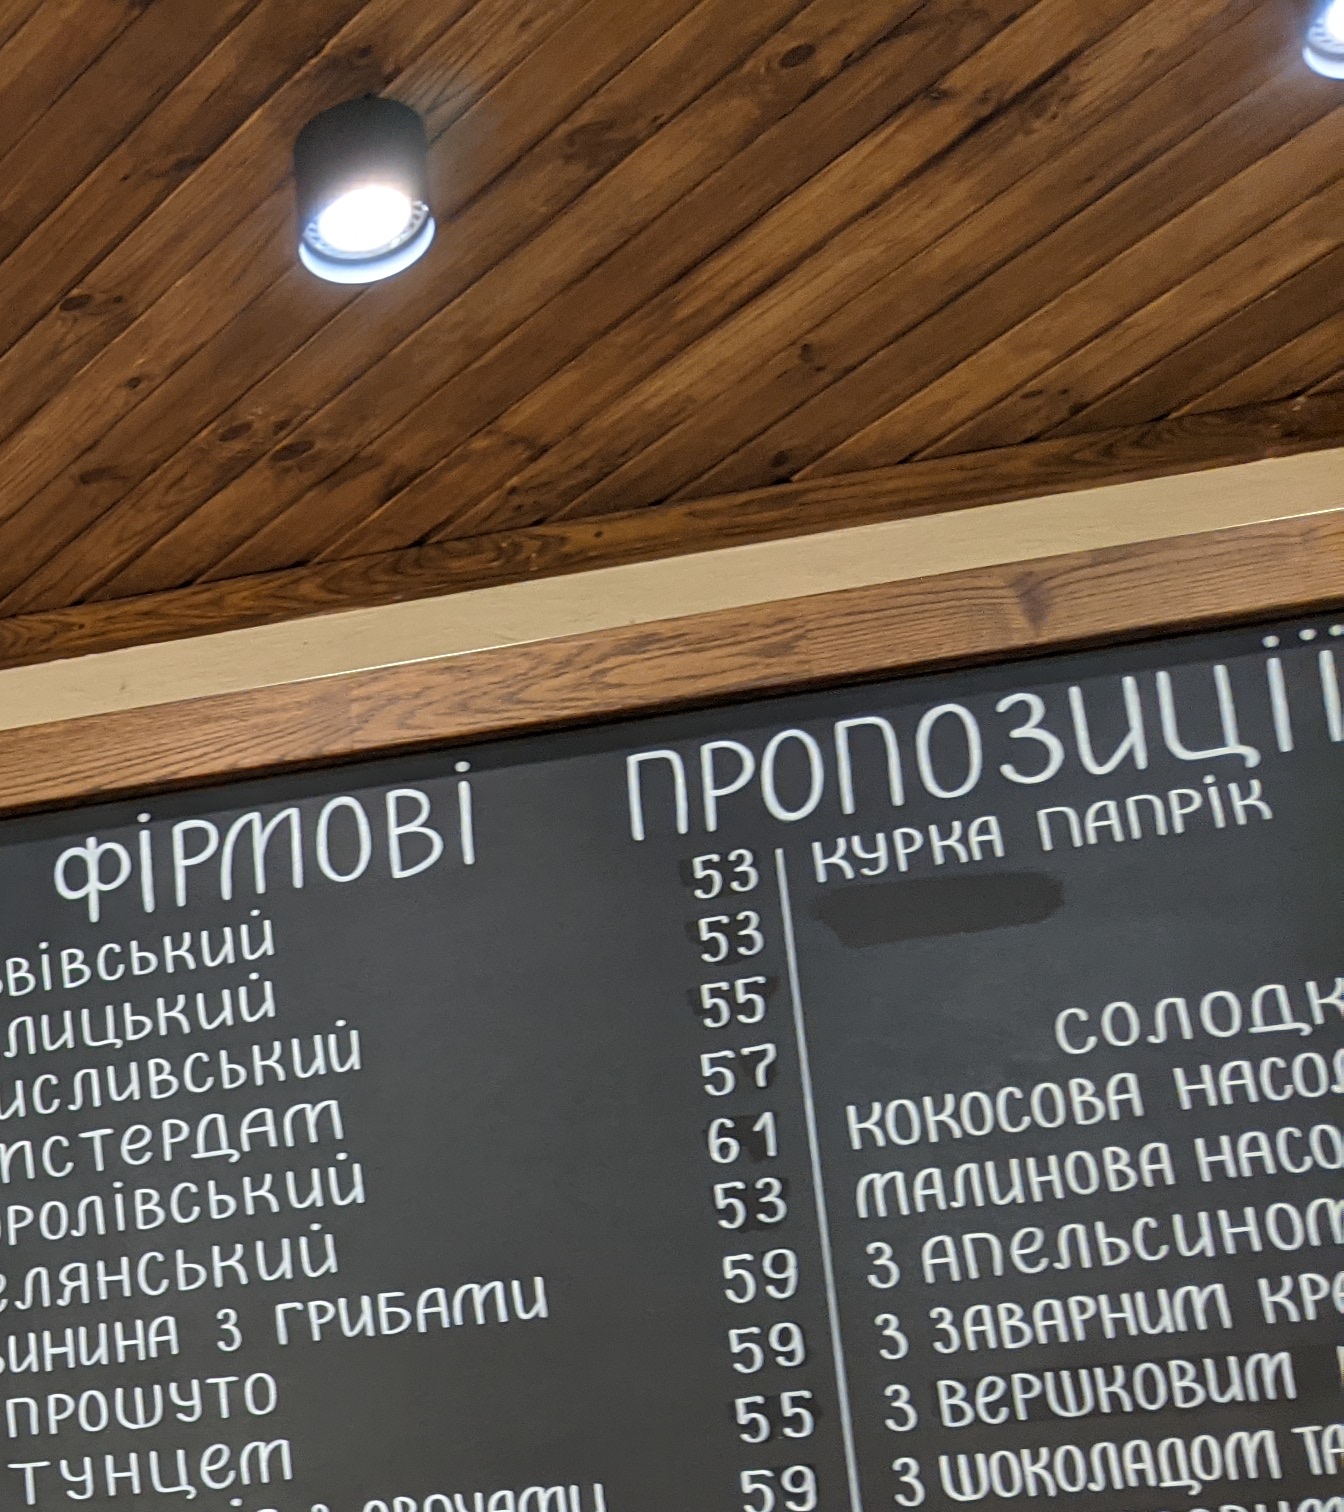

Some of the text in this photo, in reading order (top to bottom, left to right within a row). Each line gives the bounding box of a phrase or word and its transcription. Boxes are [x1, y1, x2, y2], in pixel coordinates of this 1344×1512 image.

[53, 761, 476, 923] ФІРМОВІ
[811, 774, 1273, 883] КУРКА ПАПРІК
[692, 848, 759, 899] 53
[700, 975, 767, 1028] 55
[707, 1111, 777, 1164] 61
[845, 1072, 1144, 1150] КОКОСОВА
[855, 1141, 1176, 1219] МАЛИНОВА
[274, 1276, 549, 1346] ГРИБАМИ
[722, 1248, 798, 1304] 59
[929, 1282, 1233, 1354] ЗАВАРНИМ
[5, 1372, 278, 1439] ПРОШУТО
[734, 1389, 814, 1444] 55
[937, 1429, 1284, 1502] ШОКОЛАДОМ
